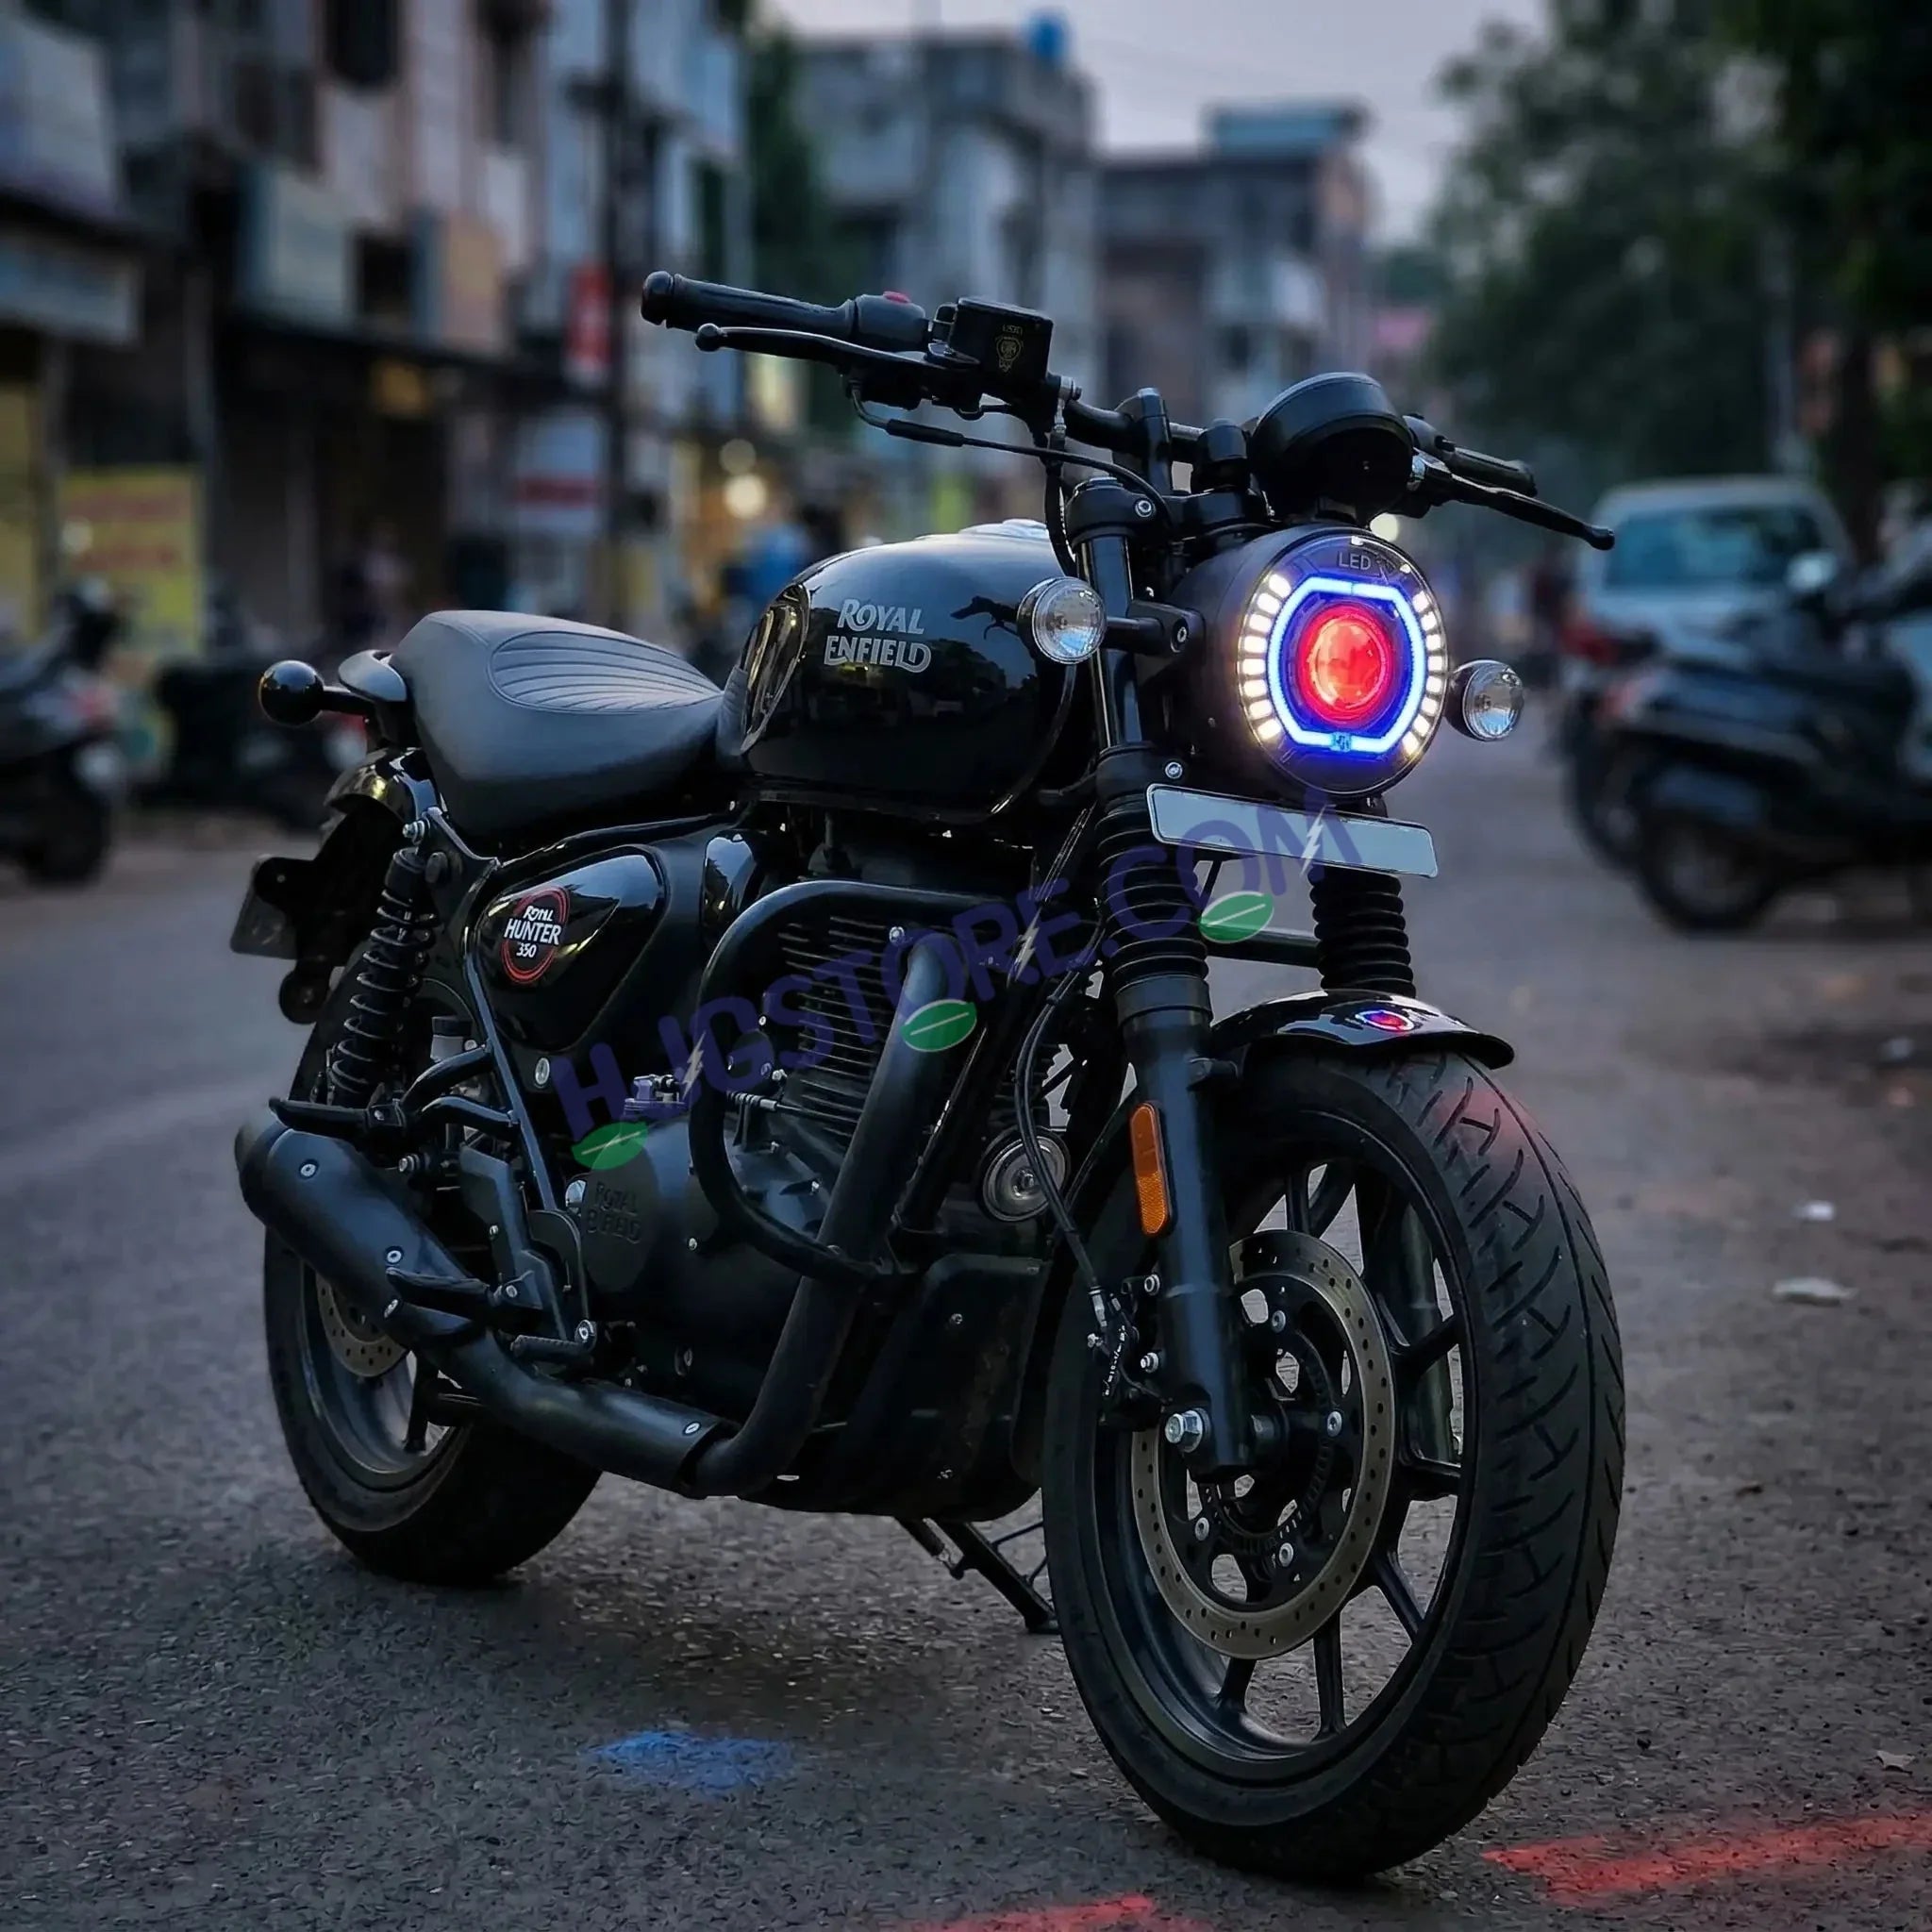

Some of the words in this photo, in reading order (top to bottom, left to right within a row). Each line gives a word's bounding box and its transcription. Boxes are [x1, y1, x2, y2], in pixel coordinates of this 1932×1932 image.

[1339, 552, 1372, 571] LED
[837, 598, 924, 635] ROYAL
[824, 635, 932, 674] ENFIELD
[504, 918, 562, 946] HUNTER
[516, 942, 537, 958] 350
